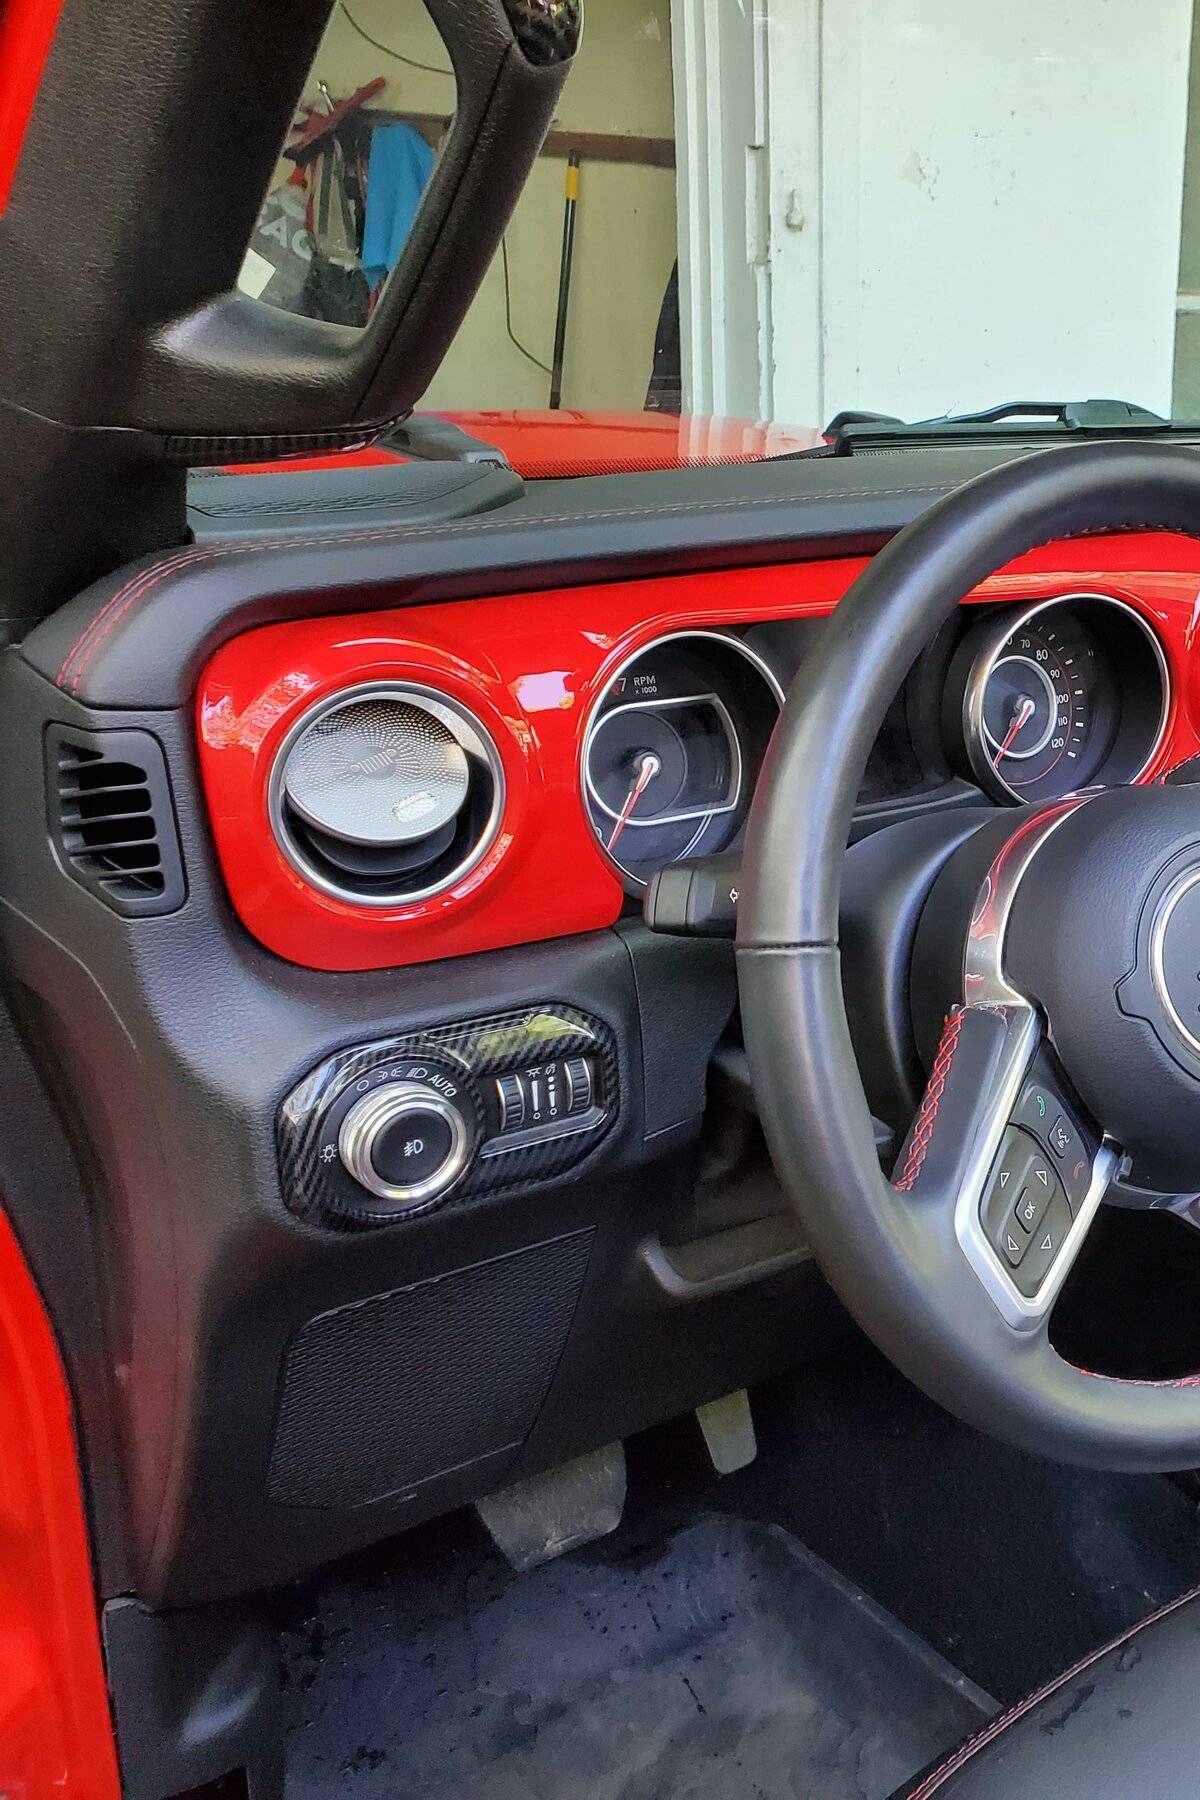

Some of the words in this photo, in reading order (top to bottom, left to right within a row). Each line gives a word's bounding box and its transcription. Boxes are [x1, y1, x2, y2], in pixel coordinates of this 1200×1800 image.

[1021, 639, 1031, 648] 70
[1036, 649, 1048, 660] 80
[1050, 669, 1060, 679] 90
[617, 677, 626, 692] 7
[633, 675, 656, 686] RPM
[641, 685, 657, 694] 1000
[1056, 693, 1069, 704] 100
[1058, 717, 1068, 727] 110
[1051, 738, 1064, 749] 120
[427, 1074, 457, 1097] AUTO
[1024, 1201, 1036, 1220] OK
